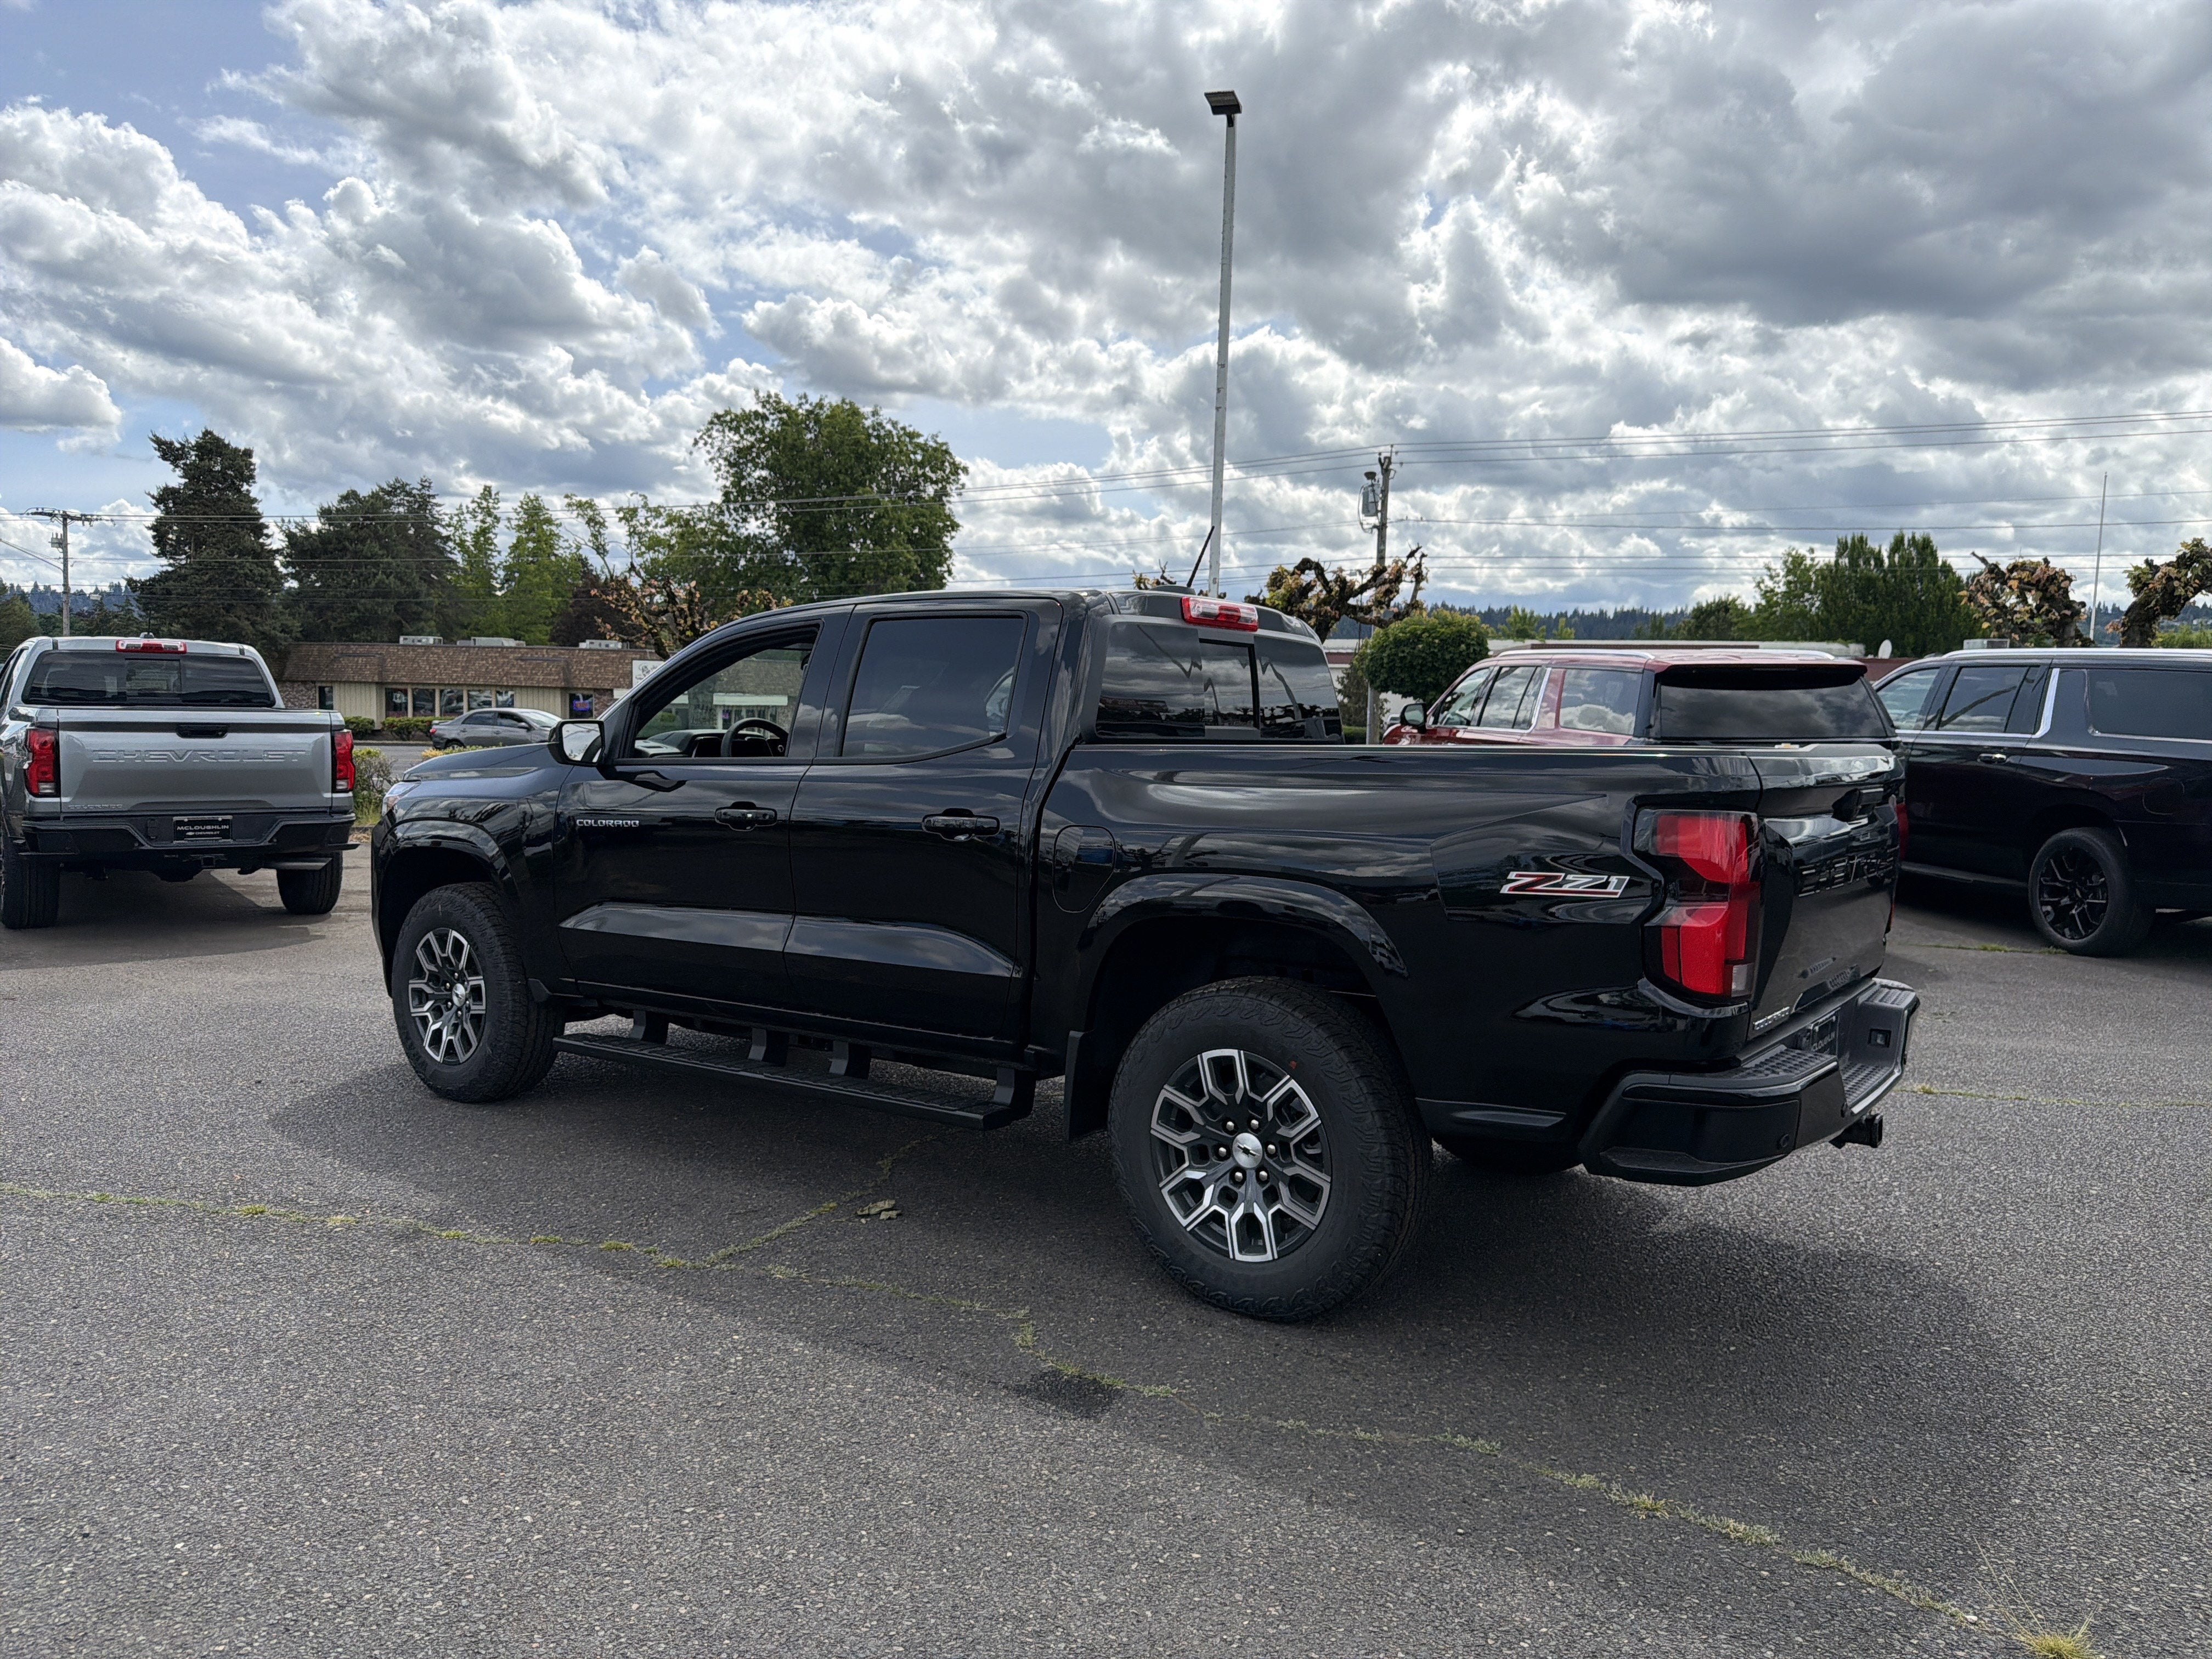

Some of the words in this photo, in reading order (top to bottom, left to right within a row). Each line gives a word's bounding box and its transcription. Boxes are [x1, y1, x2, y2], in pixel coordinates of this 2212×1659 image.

[92, 749, 306, 763] CHEVROLET
[576, 819, 639, 827] COLORADO
[1499, 871, 1631, 898] Z71
